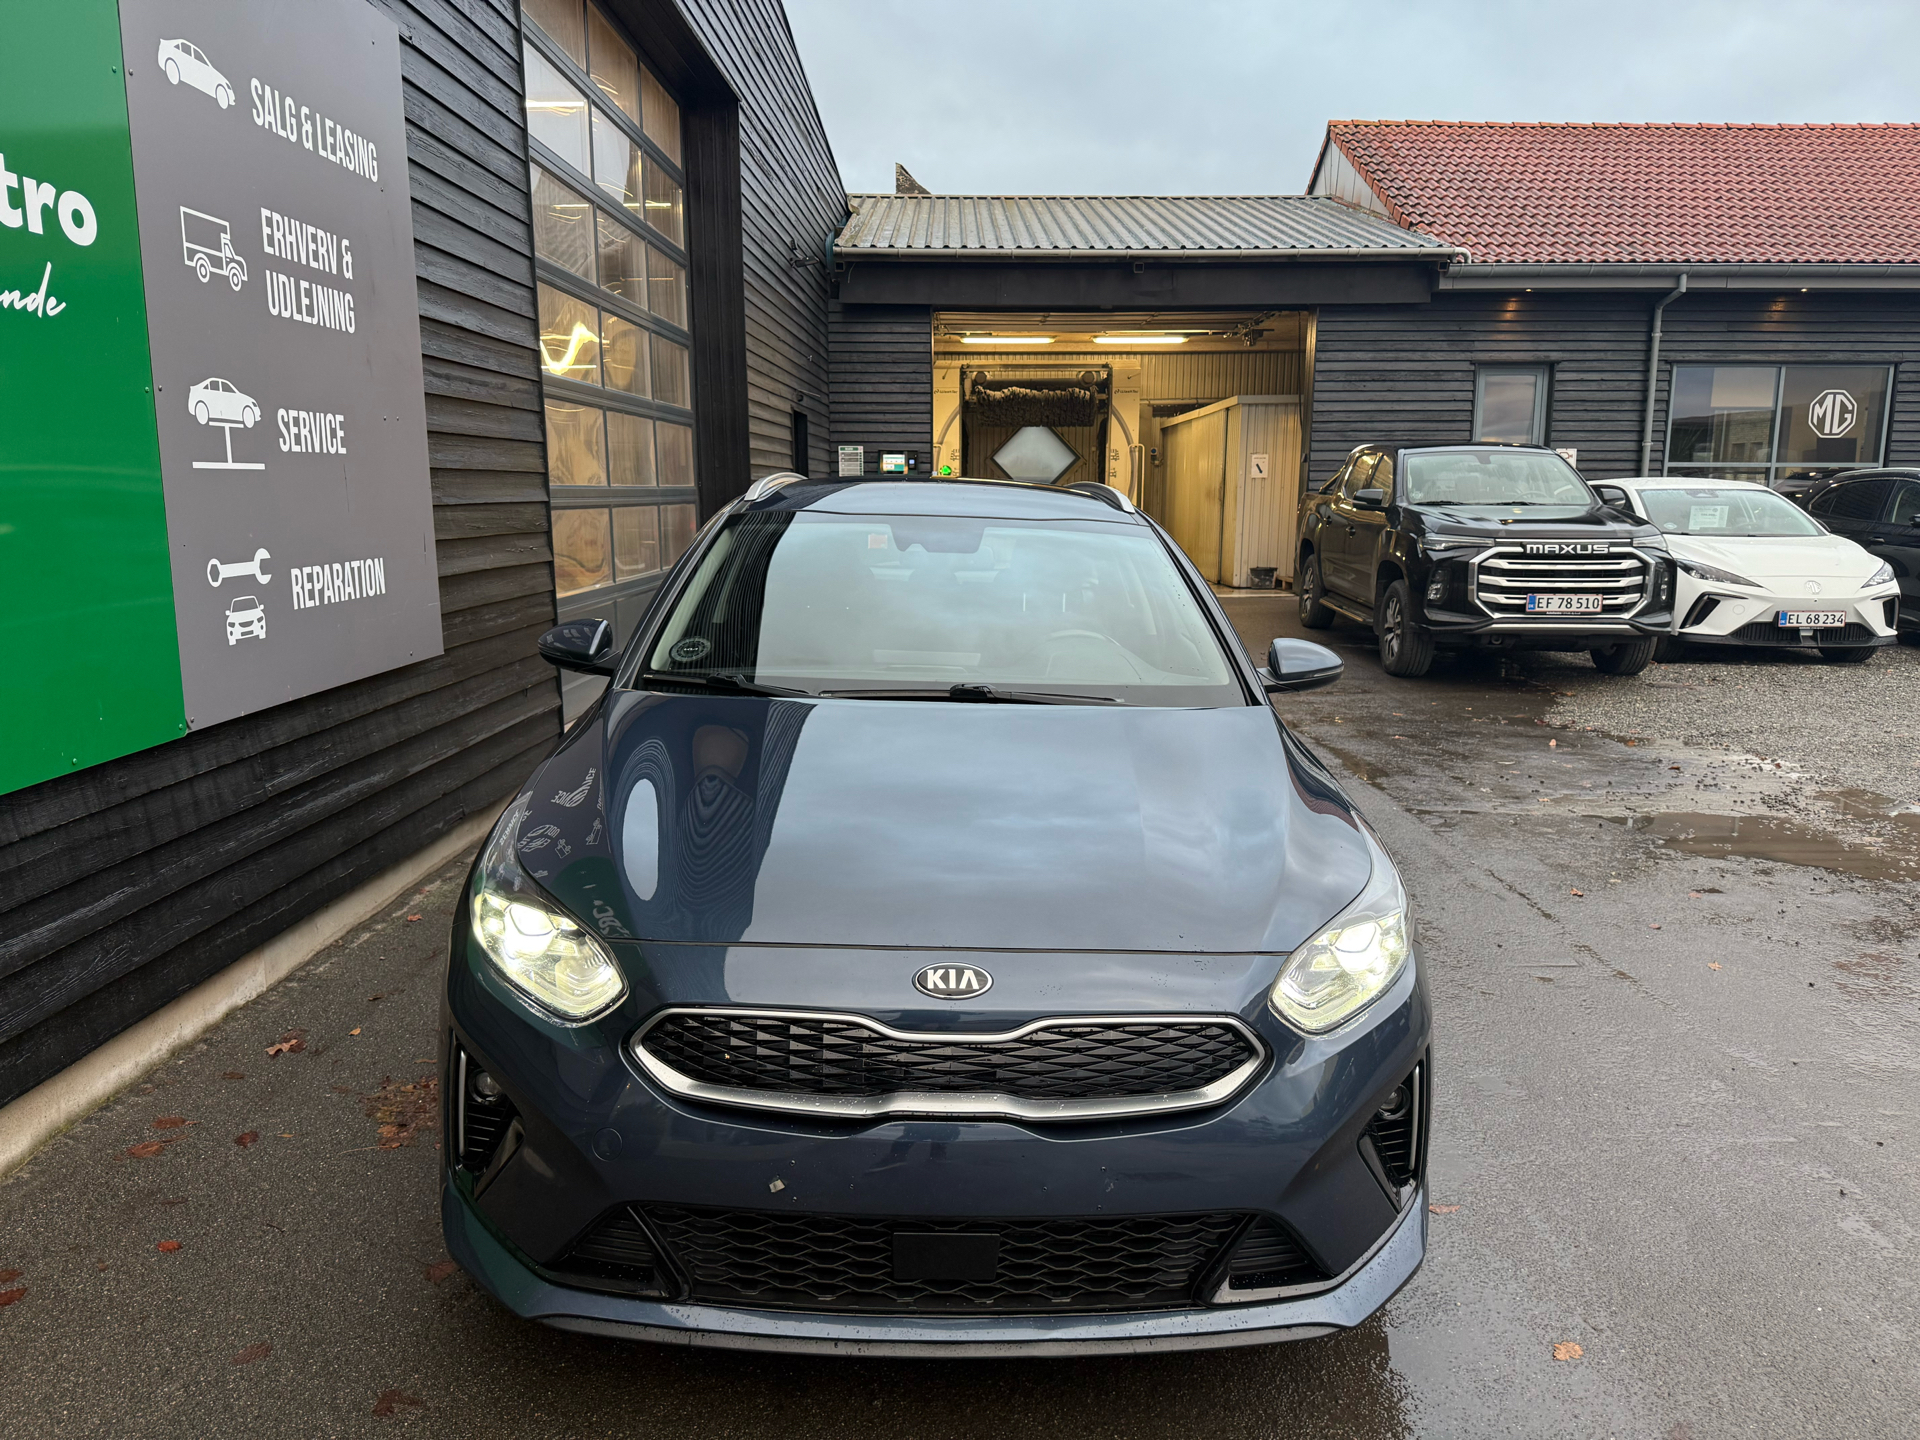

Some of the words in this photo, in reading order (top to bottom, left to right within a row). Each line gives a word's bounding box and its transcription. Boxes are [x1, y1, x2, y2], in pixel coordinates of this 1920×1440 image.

[250, 77, 298, 143] SALG
[300, 105, 313, 151] &
[315, 112, 378, 183] LEASING
[260, 206, 337, 275] ERHVERV
[341, 238, 353, 280] &
[265, 269, 356, 334] UDLEJNING
[277, 408, 347, 454] SERVICE
[1812, 394, 1853, 434] MG
[1526, 544, 1609, 554] MAXUS
[290, 557, 386, 610] REPARATION
[1537, 597, 1554, 609] EF
[1557, 597, 1573, 609] 78
[1576, 597, 1600, 609] 510
[1788, 613, 1802, 625] EL
[1805, 613, 1820, 625] 68
[1822, 613, 1844, 625] 234
[926, 968, 980, 990] KIA
